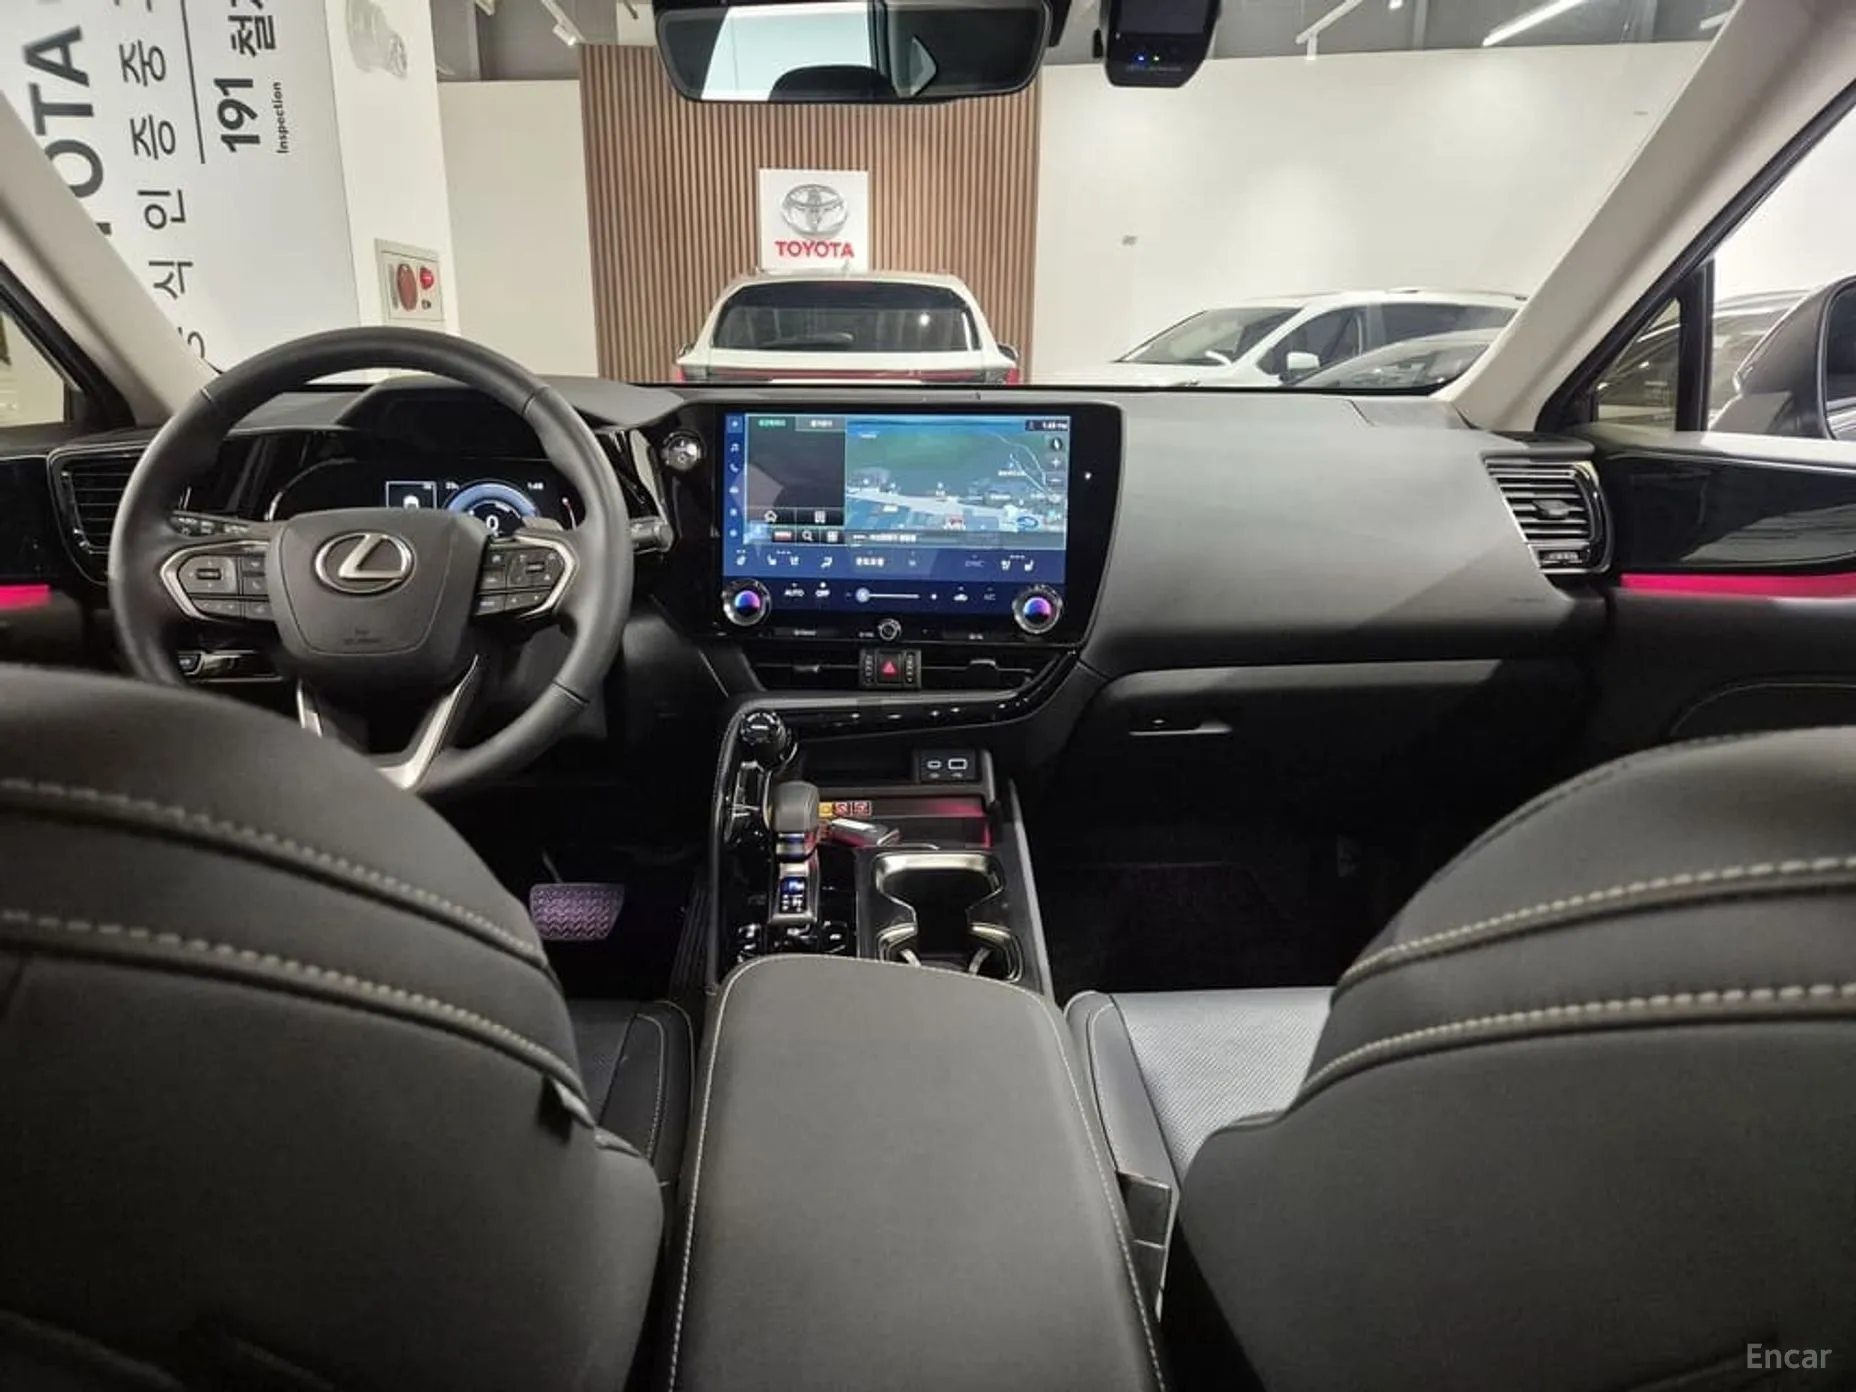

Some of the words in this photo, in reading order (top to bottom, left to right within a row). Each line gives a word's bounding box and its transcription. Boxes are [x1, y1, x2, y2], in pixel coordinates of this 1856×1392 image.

[227, 0, 277, 58] 철
[213, 77, 261, 152] 191
[274, 81, 290, 155] Inspection
[774, 240, 855, 258] TOYOTA
